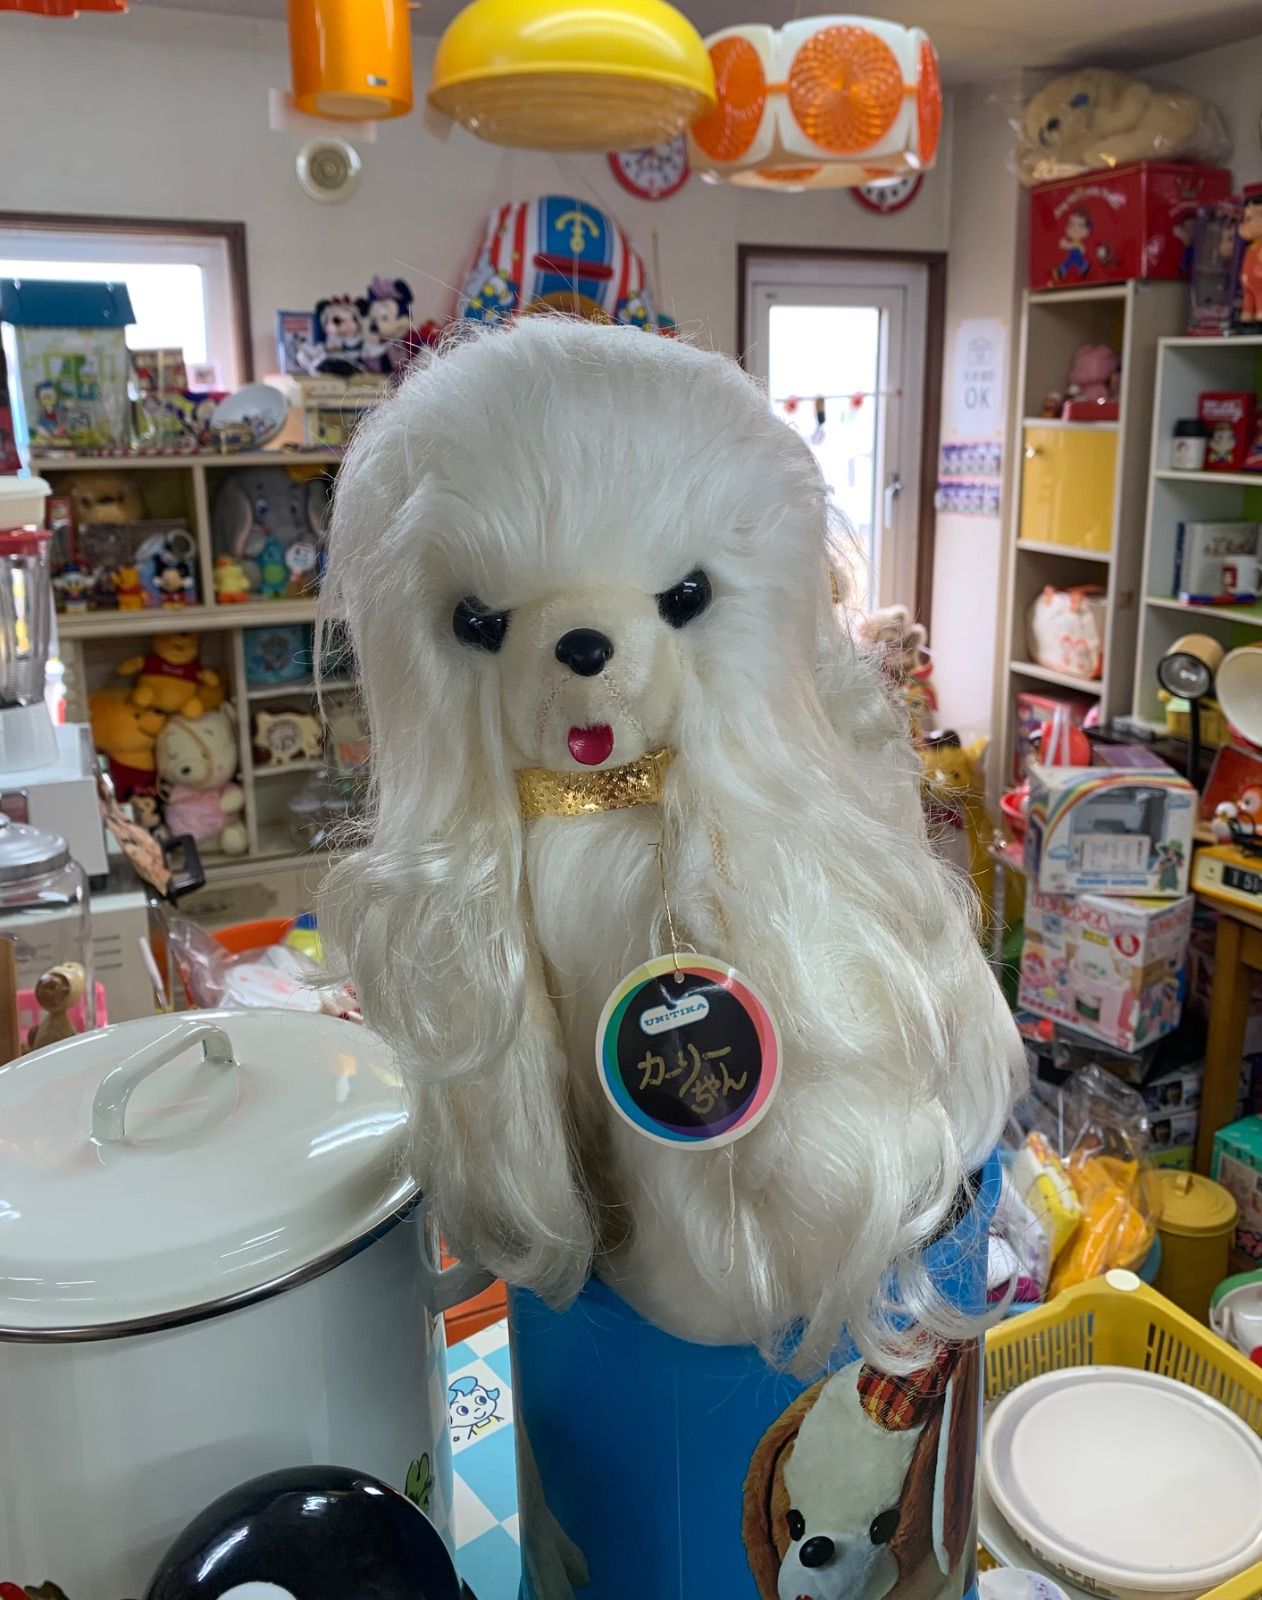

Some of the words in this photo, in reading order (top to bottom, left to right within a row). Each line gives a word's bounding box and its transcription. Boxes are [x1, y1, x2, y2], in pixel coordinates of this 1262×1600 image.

[964, 386, 991, 410] OK
[643, 1002, 707, 1027] UNITIKA
[637, 1043, 732, 1098] カーリー
